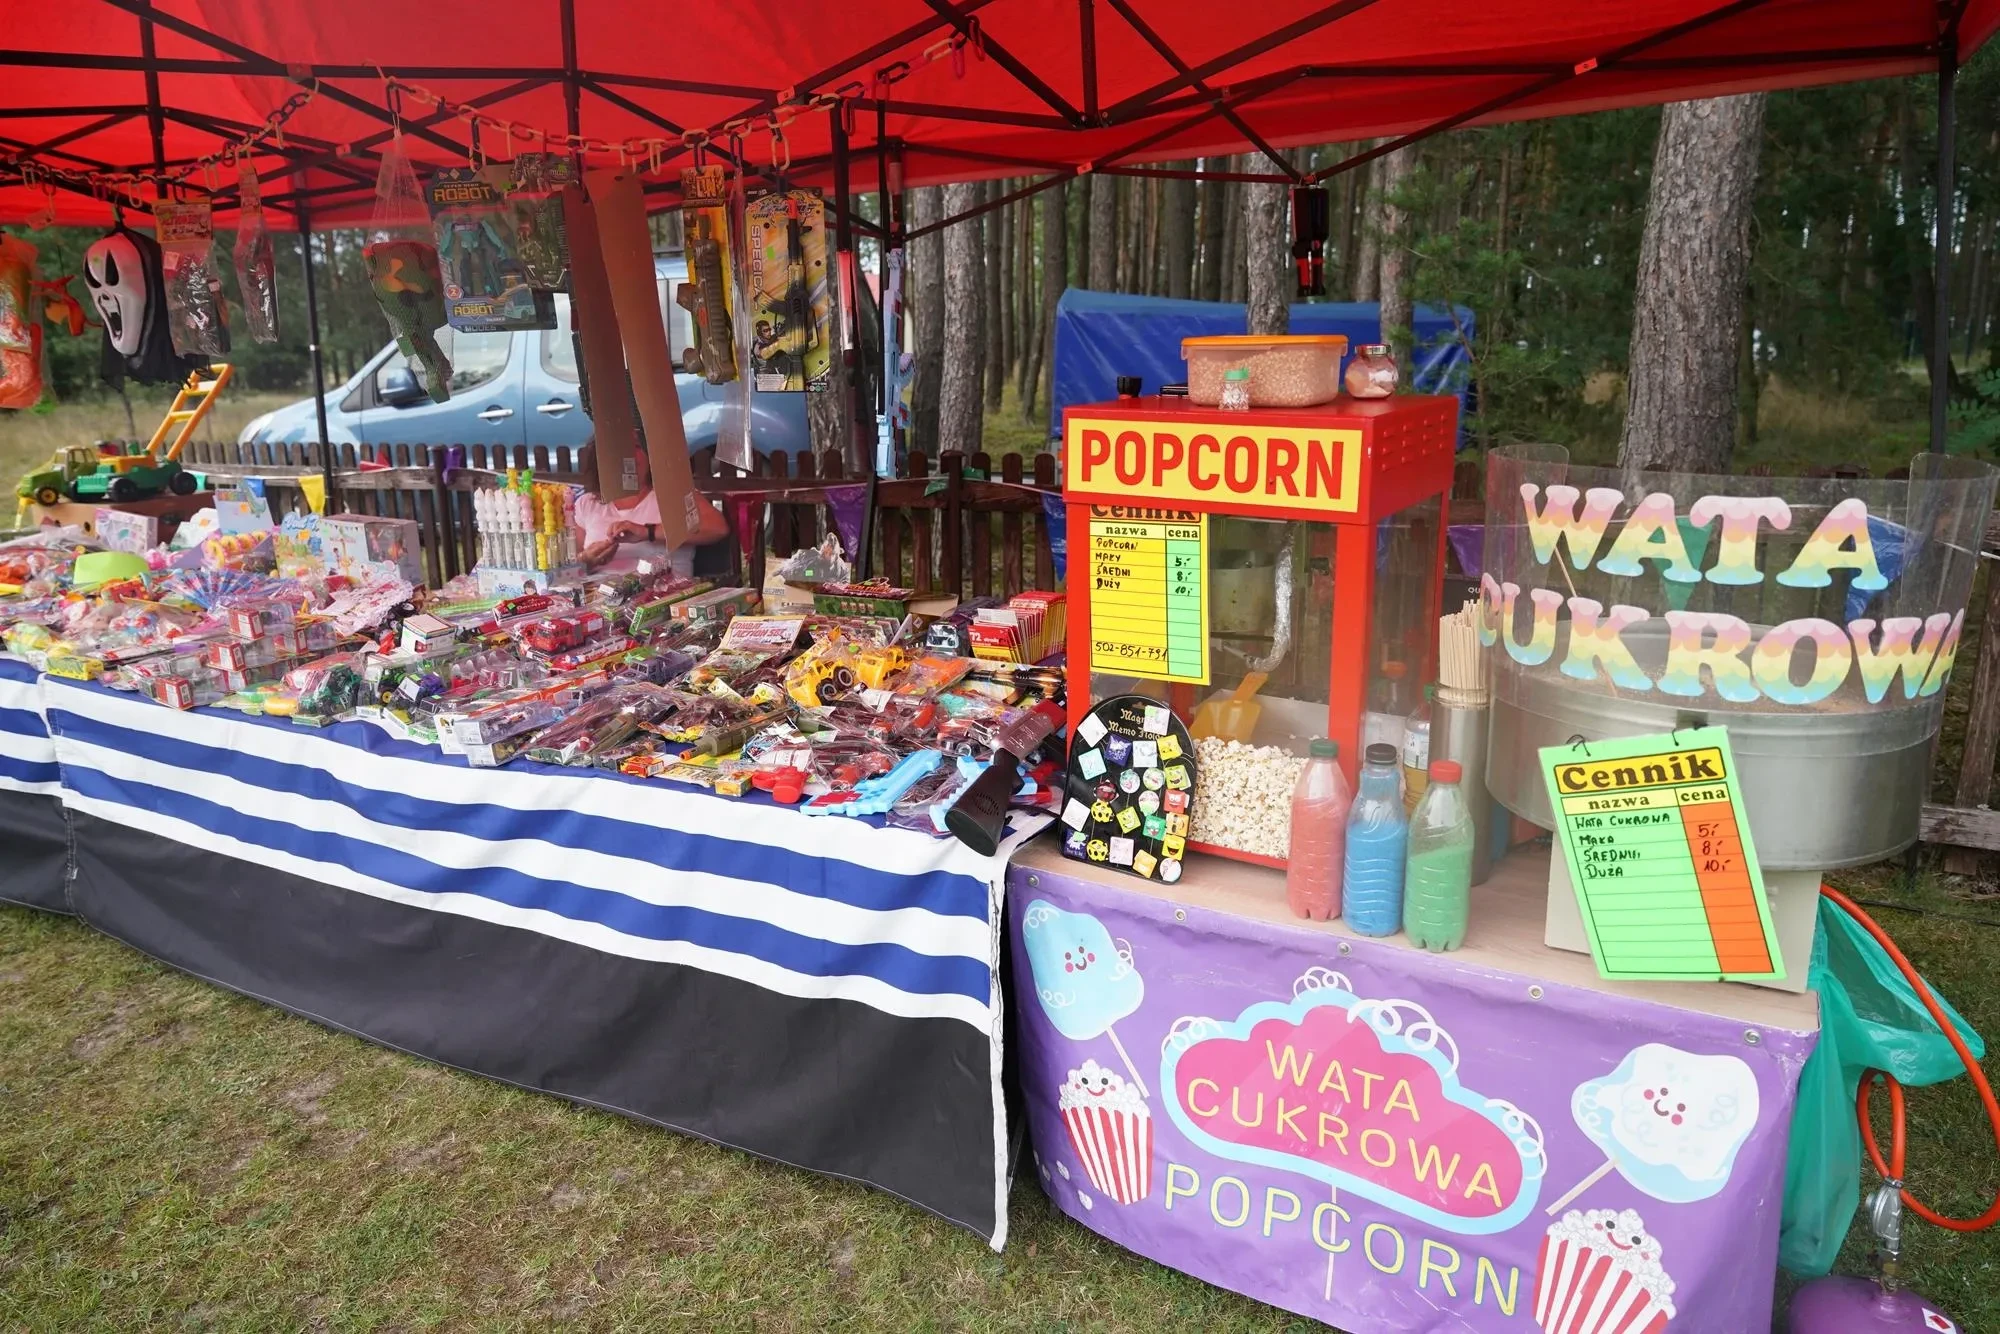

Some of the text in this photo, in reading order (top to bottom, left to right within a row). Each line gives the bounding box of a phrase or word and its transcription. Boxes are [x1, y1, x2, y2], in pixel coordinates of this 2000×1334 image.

[434, 186, 491, 201] ROBOT
[454, 305, 495, 316] ROBOT
[1081, 429, 1344, 499] POPCORN
[1105, 525, 1198, 538] nazwa cena
[1520, 483, 1888, 590] WATA
[1096, 562, 1130, 577] ŚREDNI
[1108, 720, 1136, 738] Memo
[1562, 754, 1718, 790] Cennik
[1588, 788, 1726, 810] nazwa cena
[1575, 812, 1670, 829] WATA CUKROWA
[1585, 863, 1623, 879] DUŻA
[1266, 1039, 1420, 1122] WATA
[1187, 1078, 1502, 1208] CUKROWA
[1165, 1163, 1519, 1316] POPCORN
